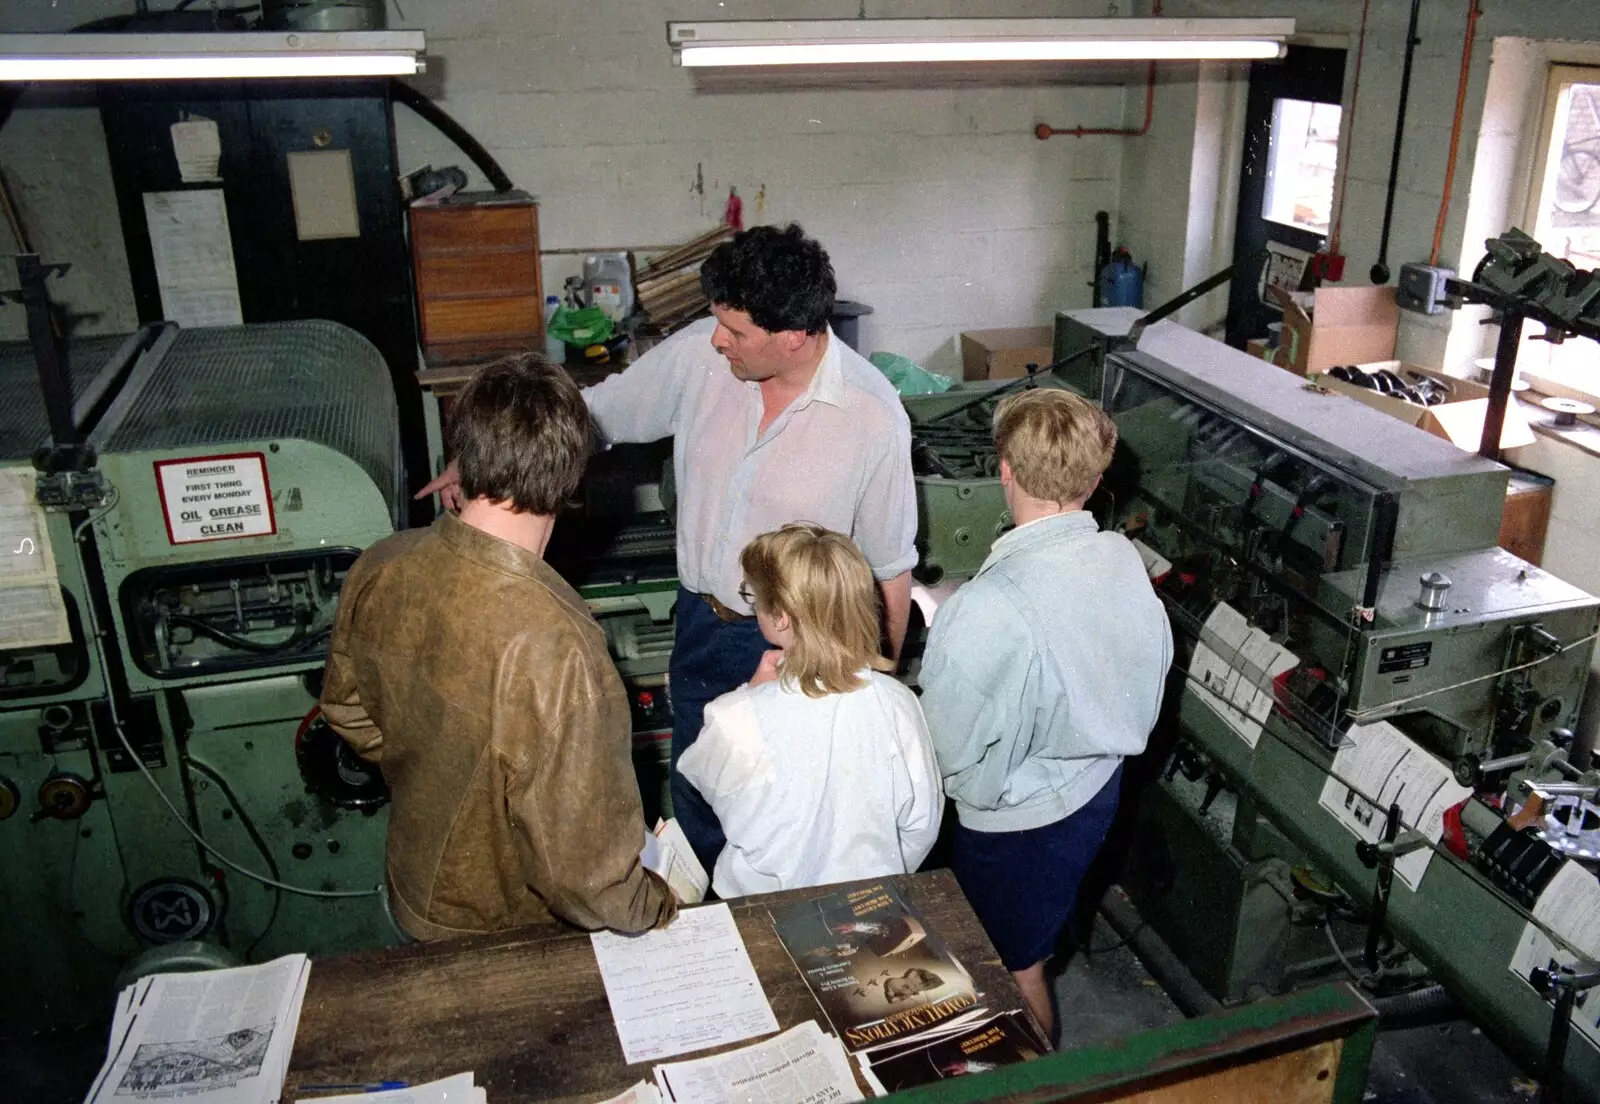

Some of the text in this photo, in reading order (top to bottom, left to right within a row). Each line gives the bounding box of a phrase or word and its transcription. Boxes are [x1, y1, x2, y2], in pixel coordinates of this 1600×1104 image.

[186, 465, 236, 477] REMINDER
[186, 480, 242, 492] FIRST THING
[182, 490, 252, 503] EVERY MONDAY
[180, 504, 261, 521] OIL GREASE
[200, 522, 244, 535] CLEAN
[844, 990, 977, 1046] COMMUNICATIONS
[768, 1061, 791, 1075] pushes
